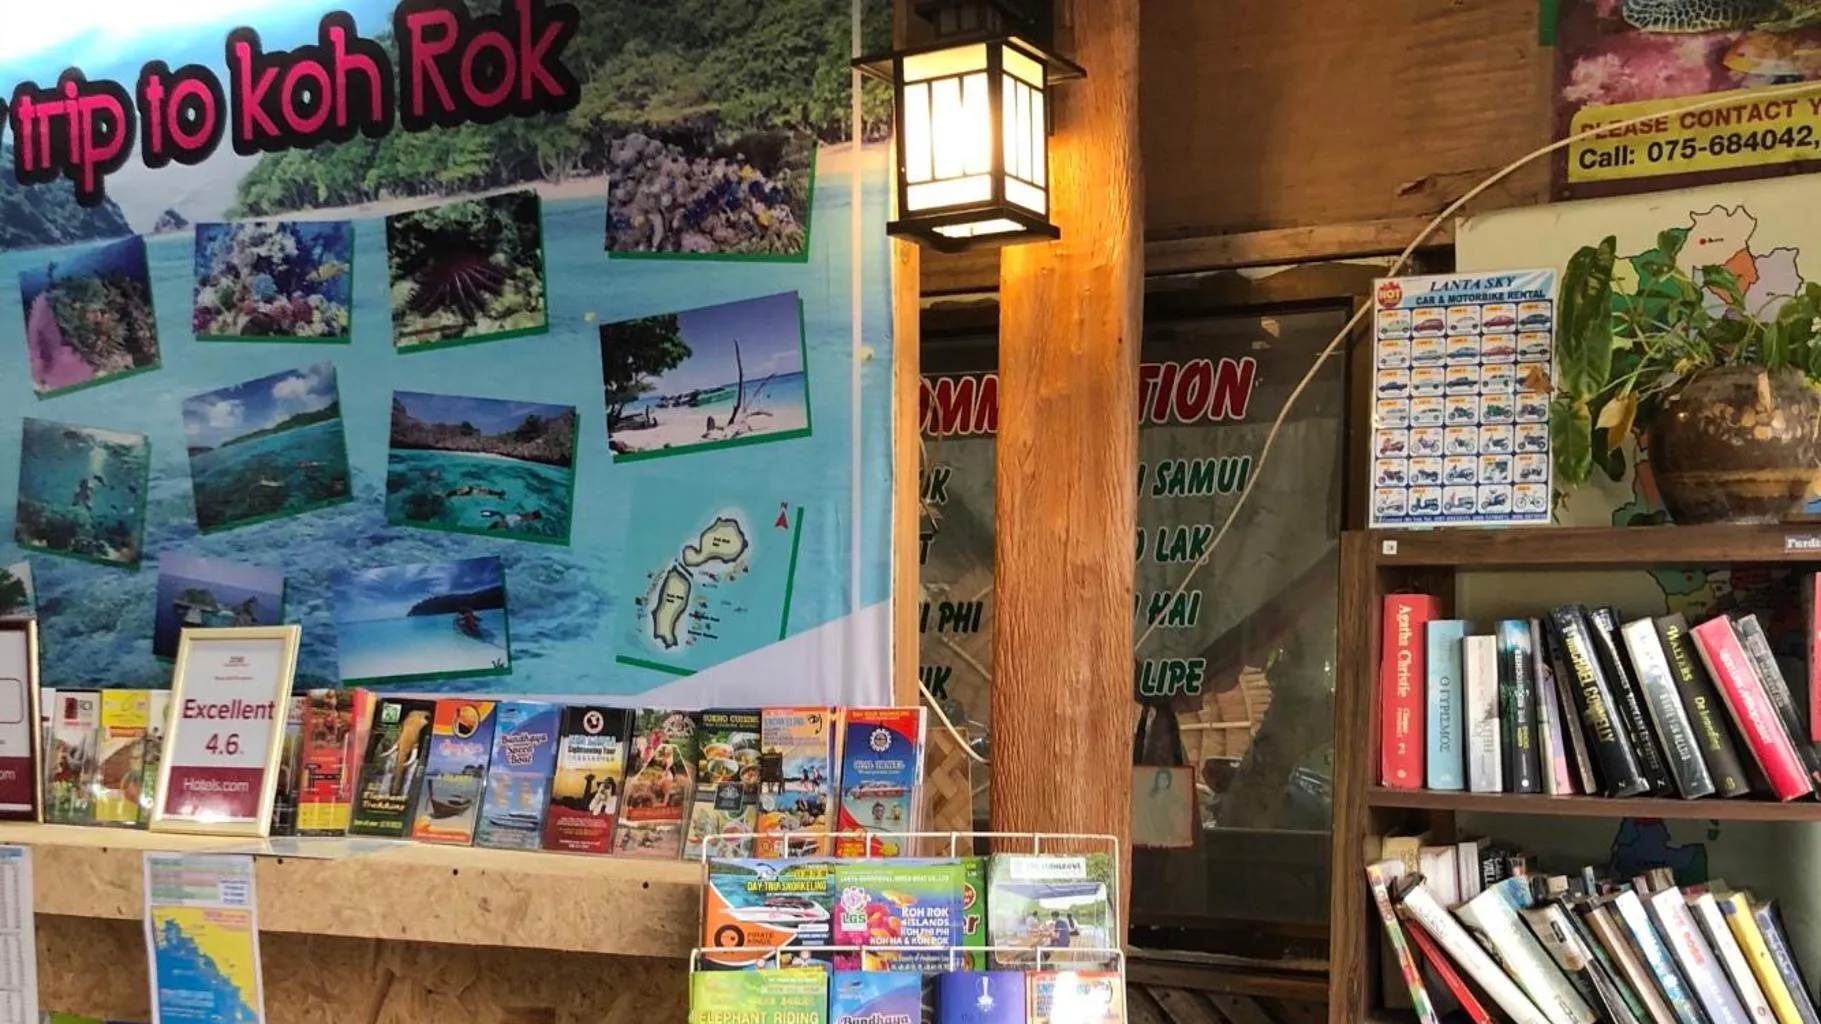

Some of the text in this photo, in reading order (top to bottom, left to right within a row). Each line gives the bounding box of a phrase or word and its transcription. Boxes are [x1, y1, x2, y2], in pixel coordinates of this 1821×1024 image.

[19, 0, 566, 193] trip to koh Rok
[1679, 100, 1798, 130] CONTACT
[1579, 125, 1820, 170] Call: 075-684042,
[1430, 275, 1516, 292] LANTA SKY
[1416, 295, 1436, 305] CAR
[1448, 291, 1505, 303] MOTORBIKE
[1507, 289, 1546, 299] RENTAL
[1152, 455, 1251, 498] SAMUI
[937, 600, 984, 635] PHI
[1395, 602, 1413, 699] Agatha Christie
[1665, 623, 1693, 682] WALTERS
[1139, 657, 1207, 698] LIPE
[182, 698, 276, 721] Excellent
[205, 733, 240, 756] 4.6
[183, 778, 250, 793] Hotels.com
[746, 880, 762, 892] DAY
[843, 913, 866, 924] LGS
[902, 908, 949, 917] KOH ROK
[699, 1010, 820, 1024] ELEPHANT RIDING
